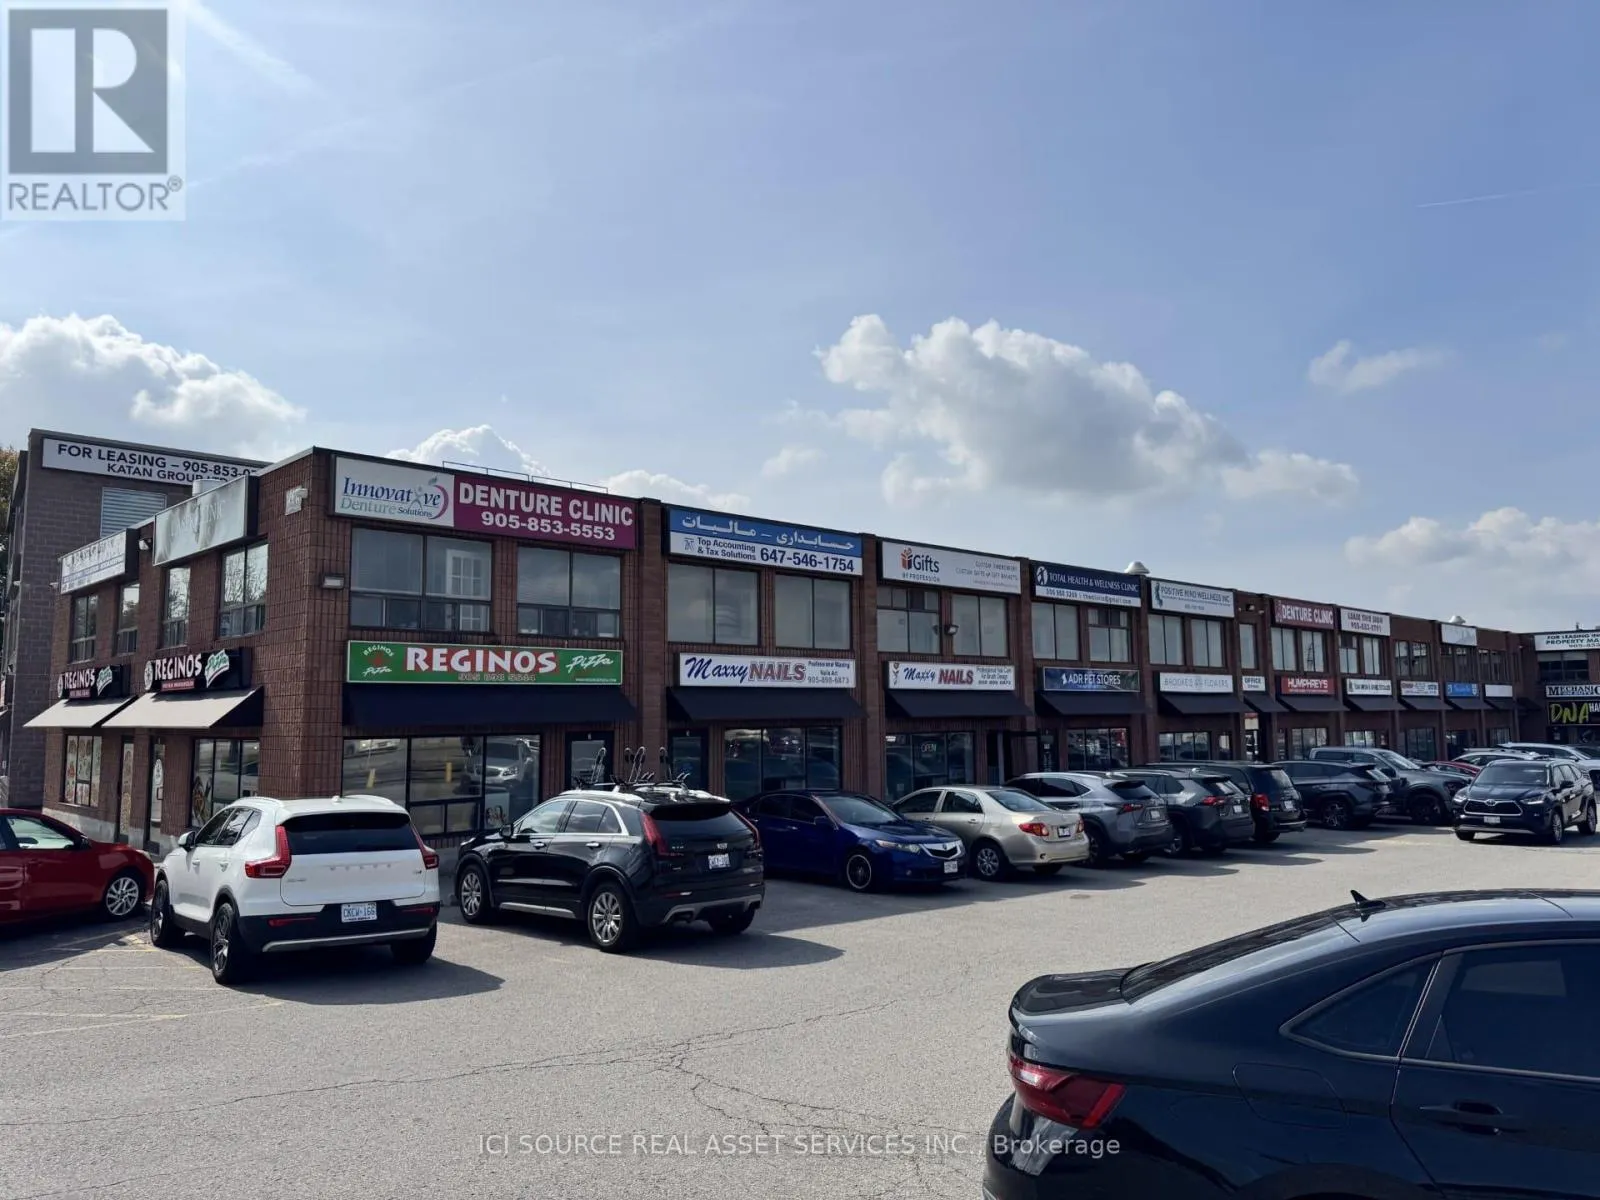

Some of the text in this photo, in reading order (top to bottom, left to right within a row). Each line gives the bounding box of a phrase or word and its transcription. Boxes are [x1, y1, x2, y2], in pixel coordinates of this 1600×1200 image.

[57, 443, 92, 459] FOR
[97, 449, 167, 468] LEASING
[107, 463, 153, 478] KATAN
[340, 498, 432, 518] Denture Solutions
[459, 482, 633, 526] DENTURE CLINIC
[481, 511, 615, 541] 905-853-5553
[682, 514, 756, 535] مالیات
[697, 537, 756, 554] Top Accounting
[706, 547, 720, 556] Tax
[721, 548, 756, 560] Solutions
[760, 548, 855, 572] 647-546-1754
[913, 555, 940, 573] Gifts
[1049, 572, 1140, 592] TOTAL HEALTH & WELLNESS CLINIC
[1282, 604, 1334, 625] DENTURE CLINIC
[364, 645, 394, 657] REGINOS
[406, 647, 557, 673] REGINOS
[155, 654, 202, 680] REGINOS
[362, 666, 393, 678] Pizza
[566, 653, 614, 674] Pizza
[685, 657, 806, 684] Maxxy NAILS
[64, 669, 96, 690] REGINOS
[938, 668, 974, 685] NAILS
[1068, 674, 1120, 685] ADR PET STORES
[1551, 702, 1589, 724] DNA
[921, 744, 937, 752] OPEN
